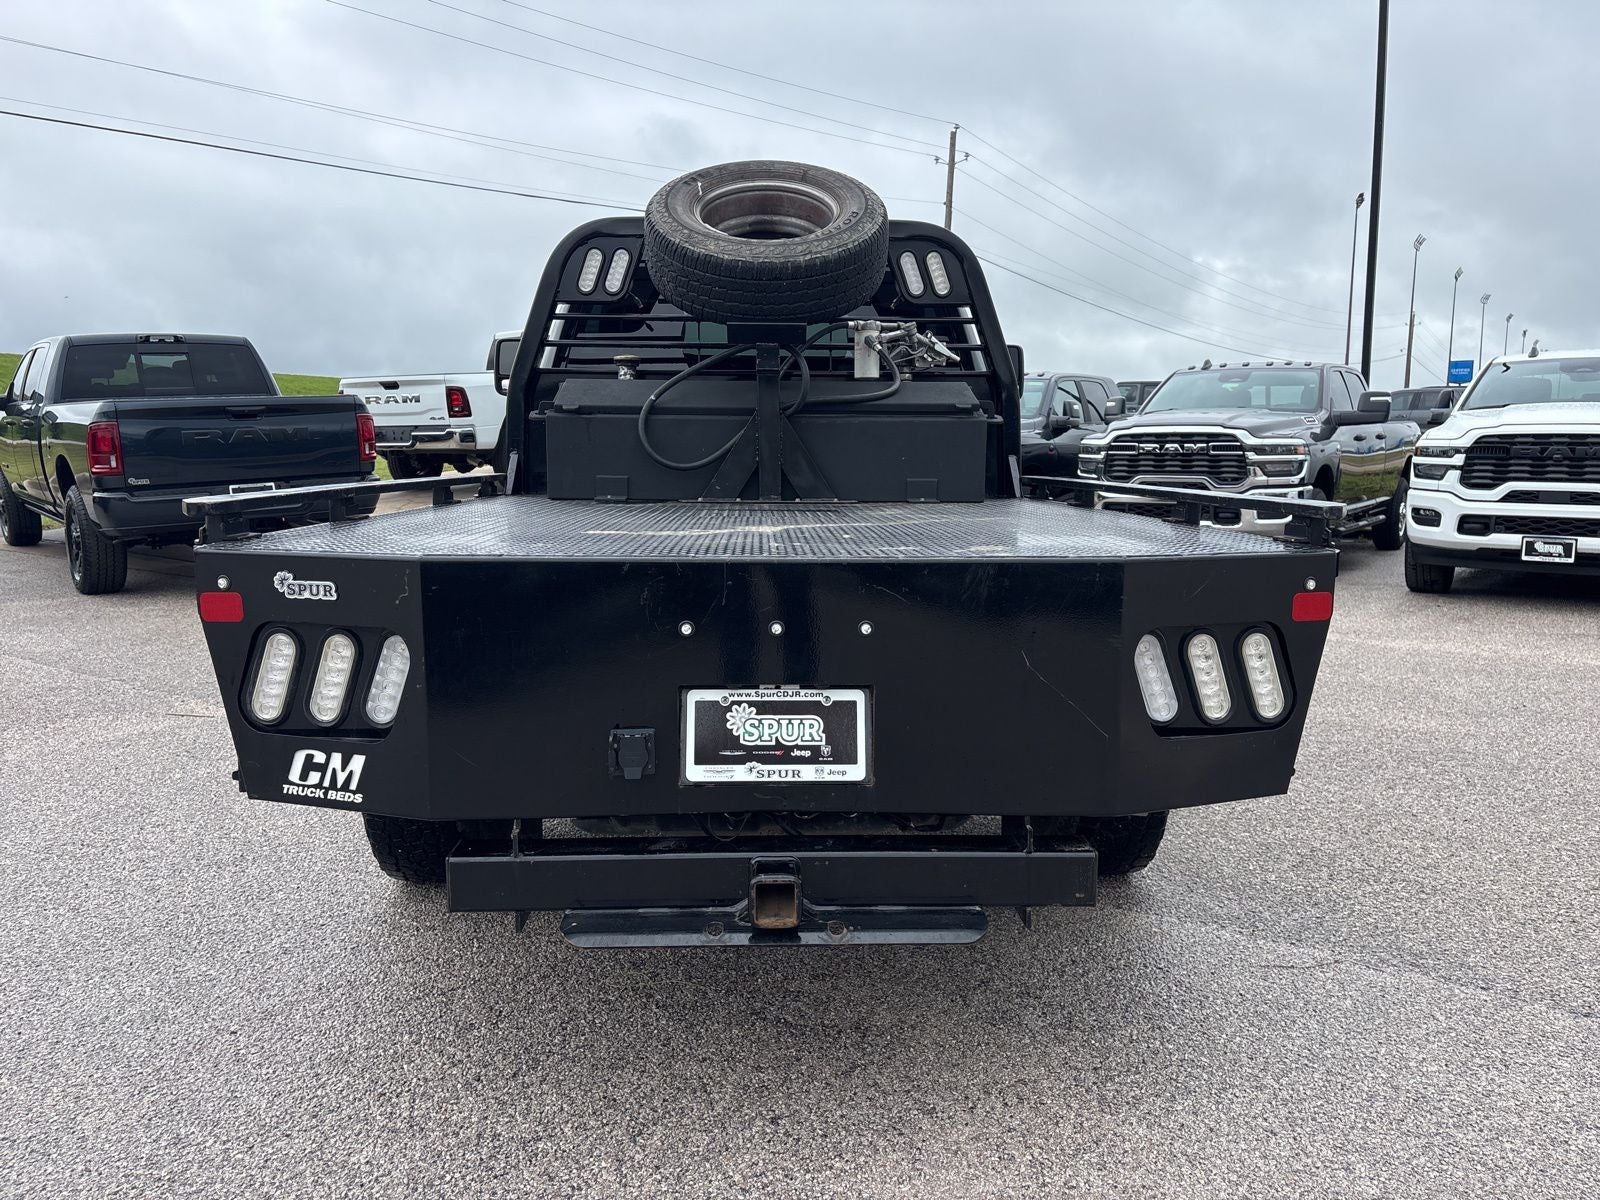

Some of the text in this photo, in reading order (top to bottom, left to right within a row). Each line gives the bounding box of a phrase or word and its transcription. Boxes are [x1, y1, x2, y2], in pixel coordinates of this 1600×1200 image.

[365, 394, 421, 405] RAM
[181, 425, 309, 446] RAM
[1139, 443, 1207, 454] RAM
[287, 583, 334, 597] SPUR
[728, 690, 824, 699] www.SpurCDJR.com
[742, 717, 823, 742] SPUR
[790, 748, 811, 757] Jeep
[288, 749, 366, 790] CM
[756, 769, 801, 778] SPUR
[282, 784, 363, 803] TRUCK BEDS
